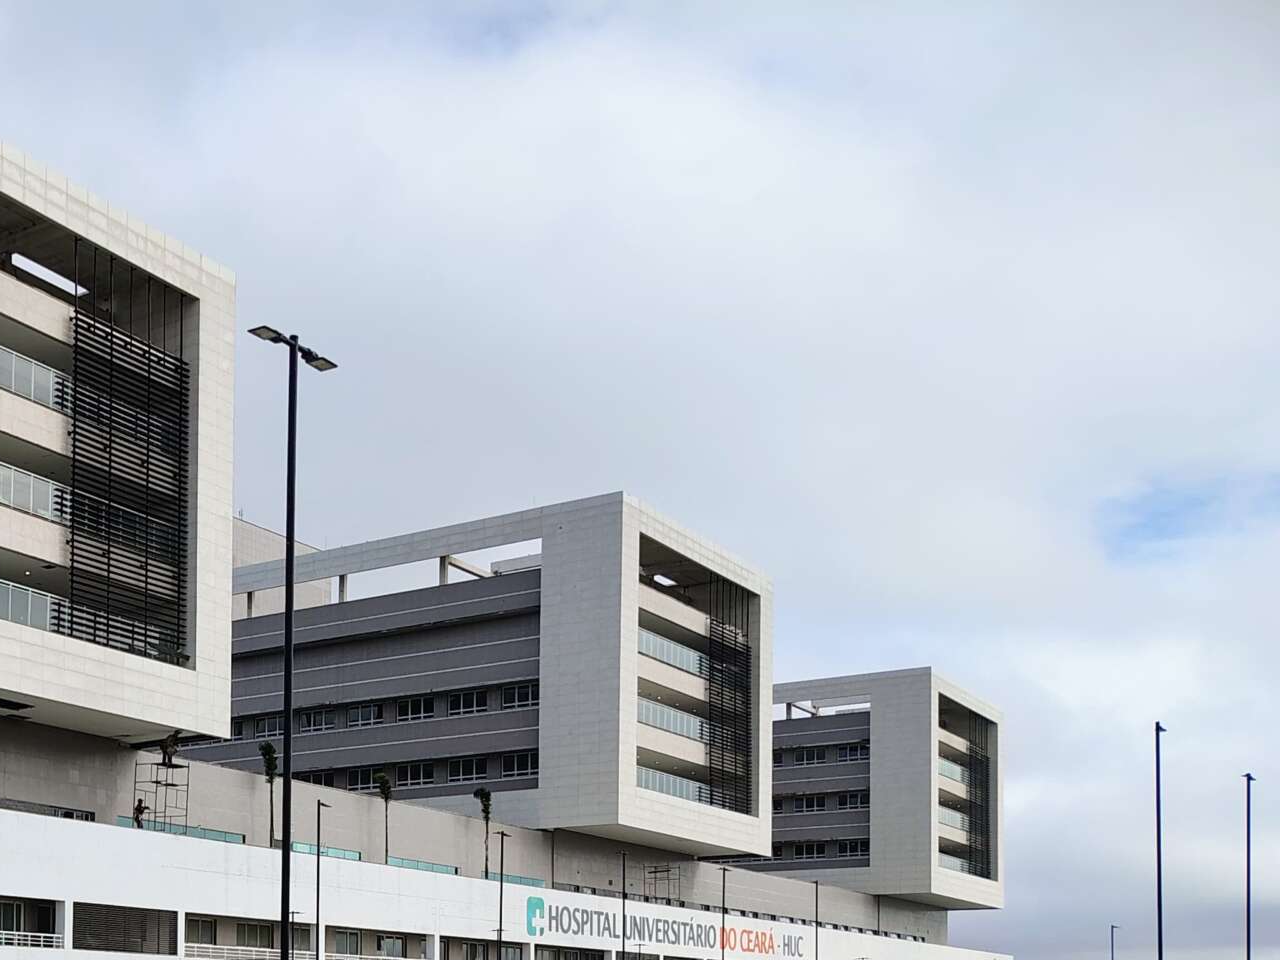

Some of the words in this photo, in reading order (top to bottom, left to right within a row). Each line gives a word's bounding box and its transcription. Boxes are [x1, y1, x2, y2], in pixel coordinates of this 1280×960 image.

[548, 904, 620, 939] HOSPITAL
[624, 916, 717, 949] UNIVERSITÁRIO
[719, 927, 737, 952] DO
[740, 927, 775, 955] CEARÁ
[782, 934, 804, 958] HUC
